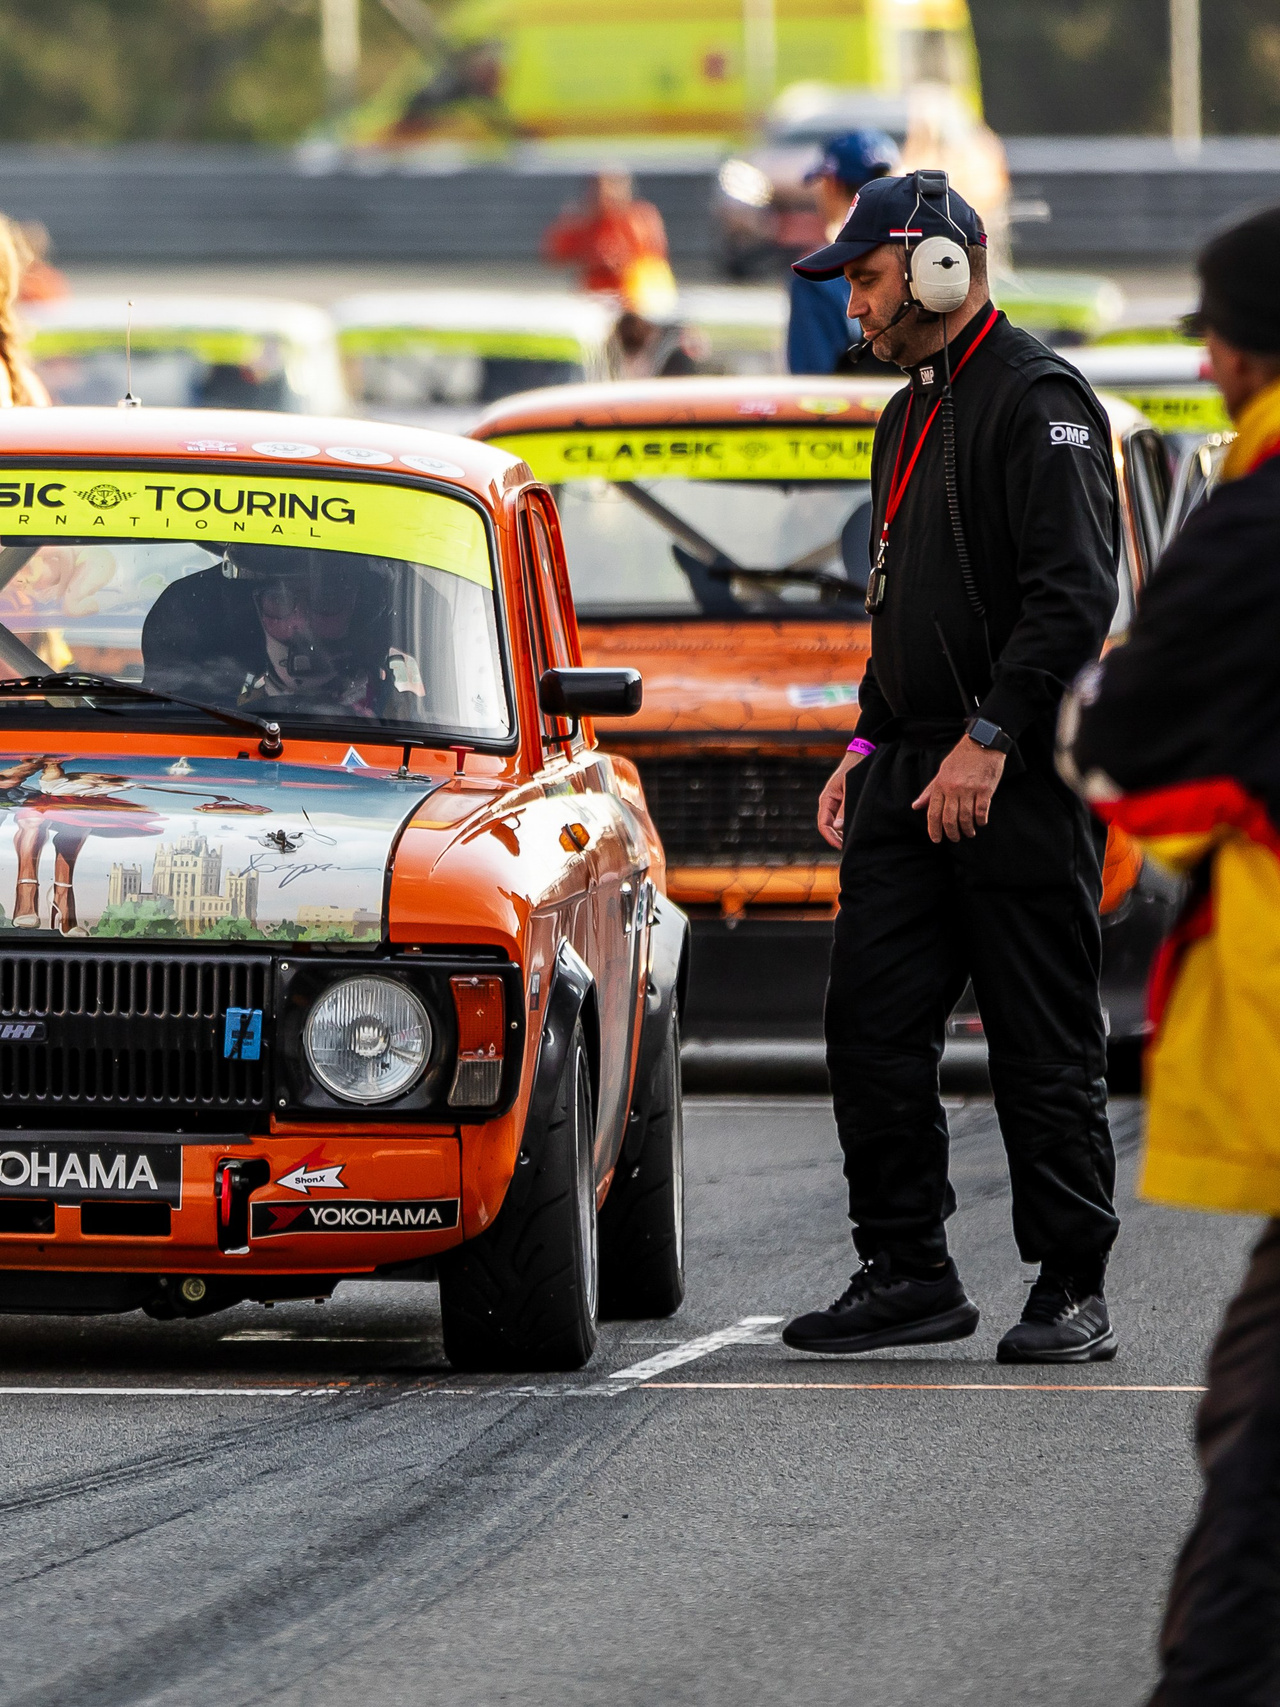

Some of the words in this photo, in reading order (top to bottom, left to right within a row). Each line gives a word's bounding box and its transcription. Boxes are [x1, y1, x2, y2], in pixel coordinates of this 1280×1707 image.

[920, 368, 934, 383] OMP
[1050, 425, 1090, 445] OMP
[563, 442, 724, 463] CLASSIC
[144, 485, 356, 524] TOURING
[308, 1207, 443, 1226] YOKOHAMA
